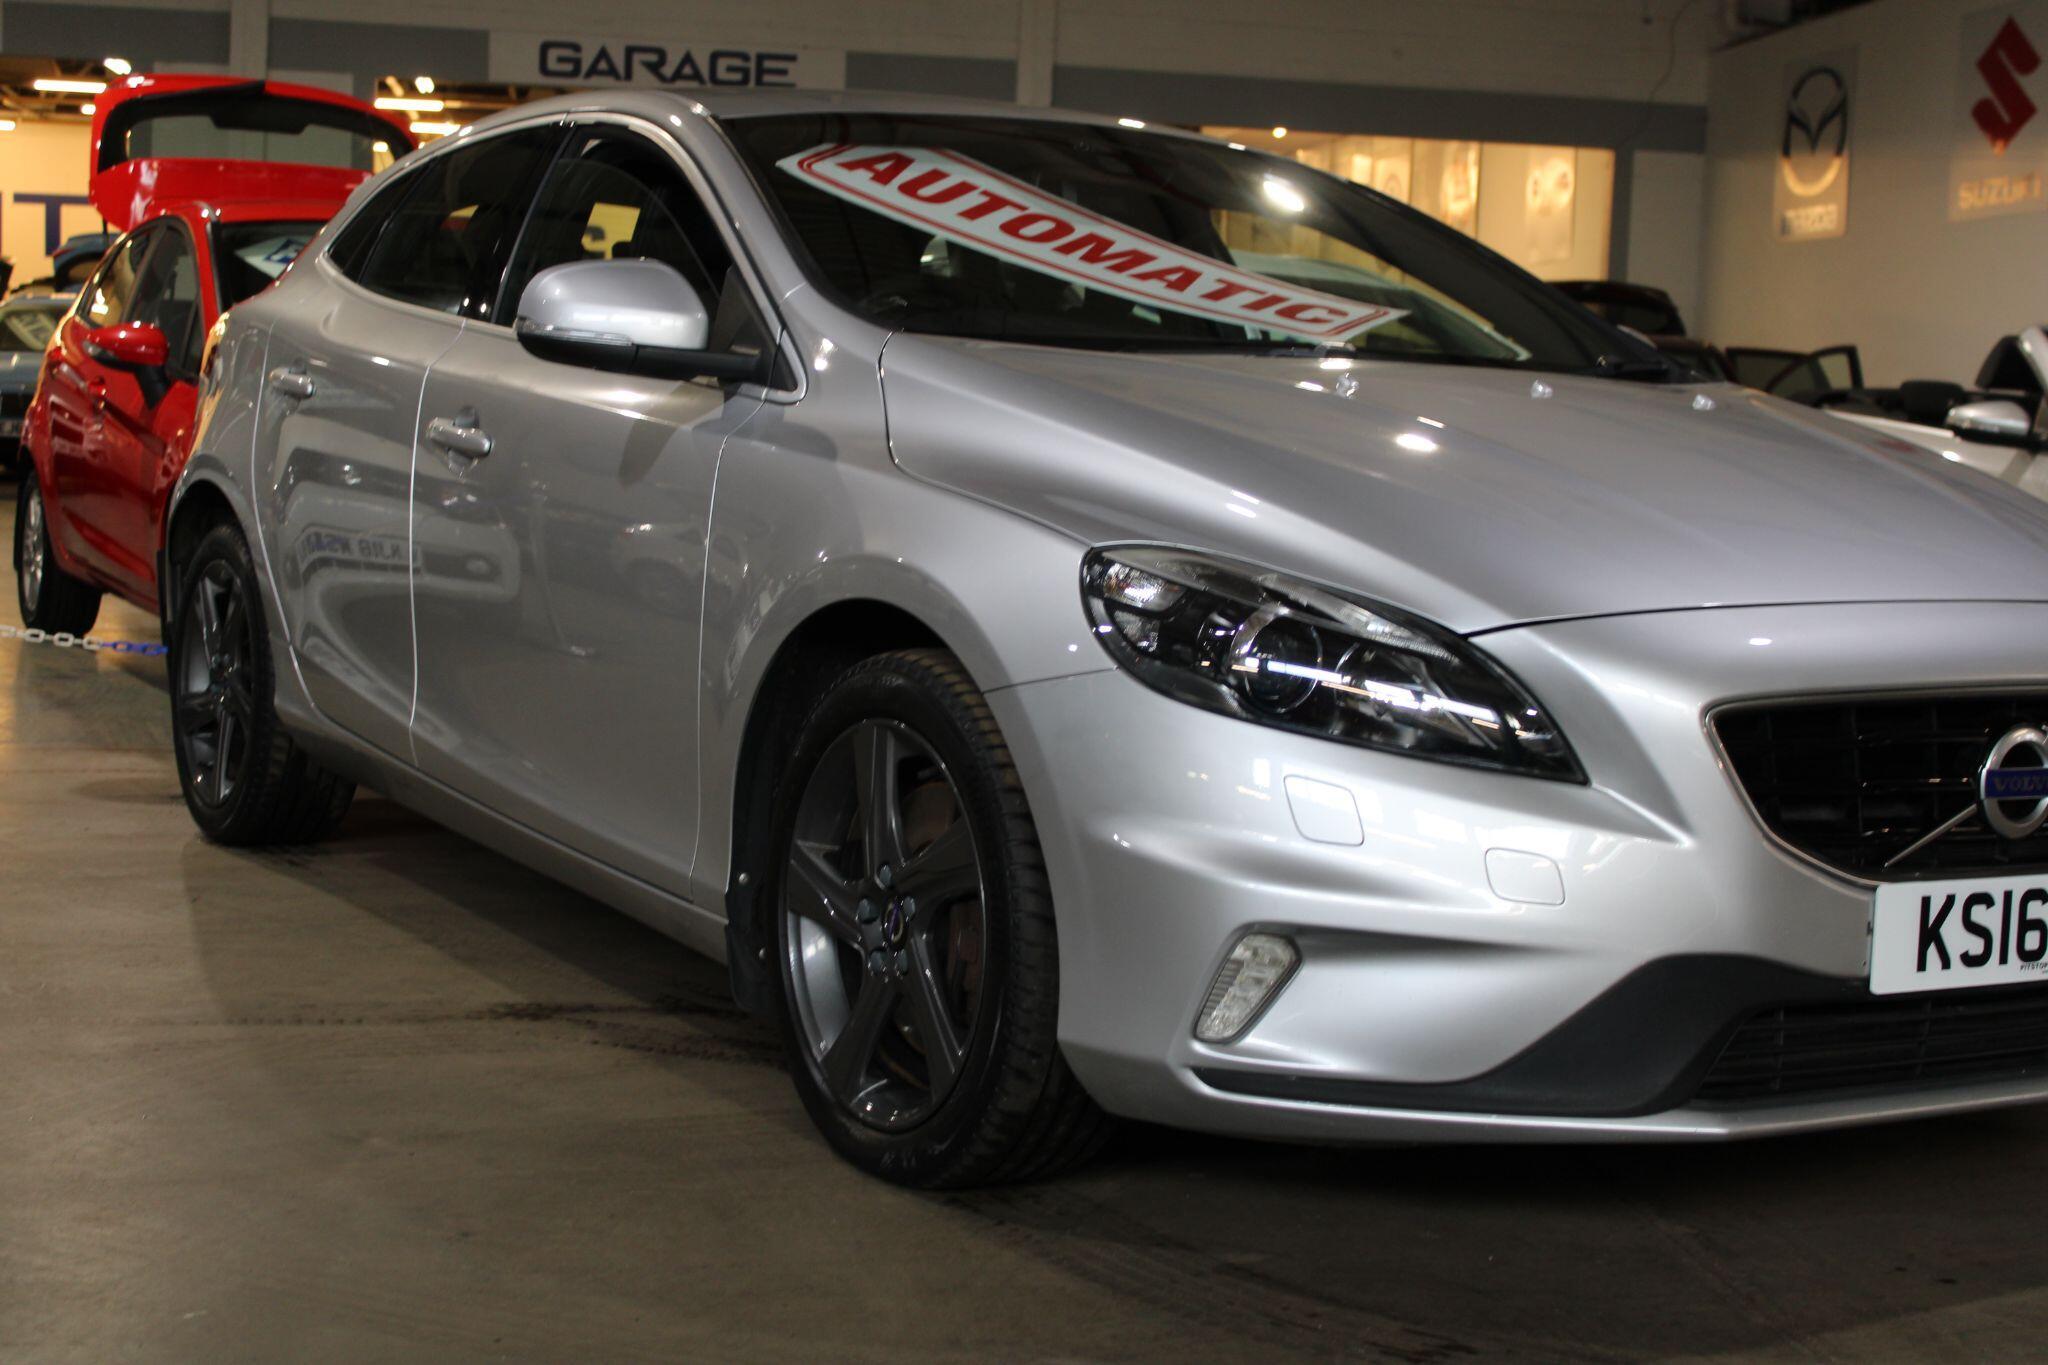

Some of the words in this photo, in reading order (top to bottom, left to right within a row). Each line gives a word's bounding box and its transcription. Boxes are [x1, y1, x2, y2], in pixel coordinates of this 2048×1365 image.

[538, 40, 798, 88] GARAGE
[837, 152, 1351, 325] AUTOMATIC
[1992, 774, 2048, 793] VOLV
[1916, 887, 2048, 973] KS16
